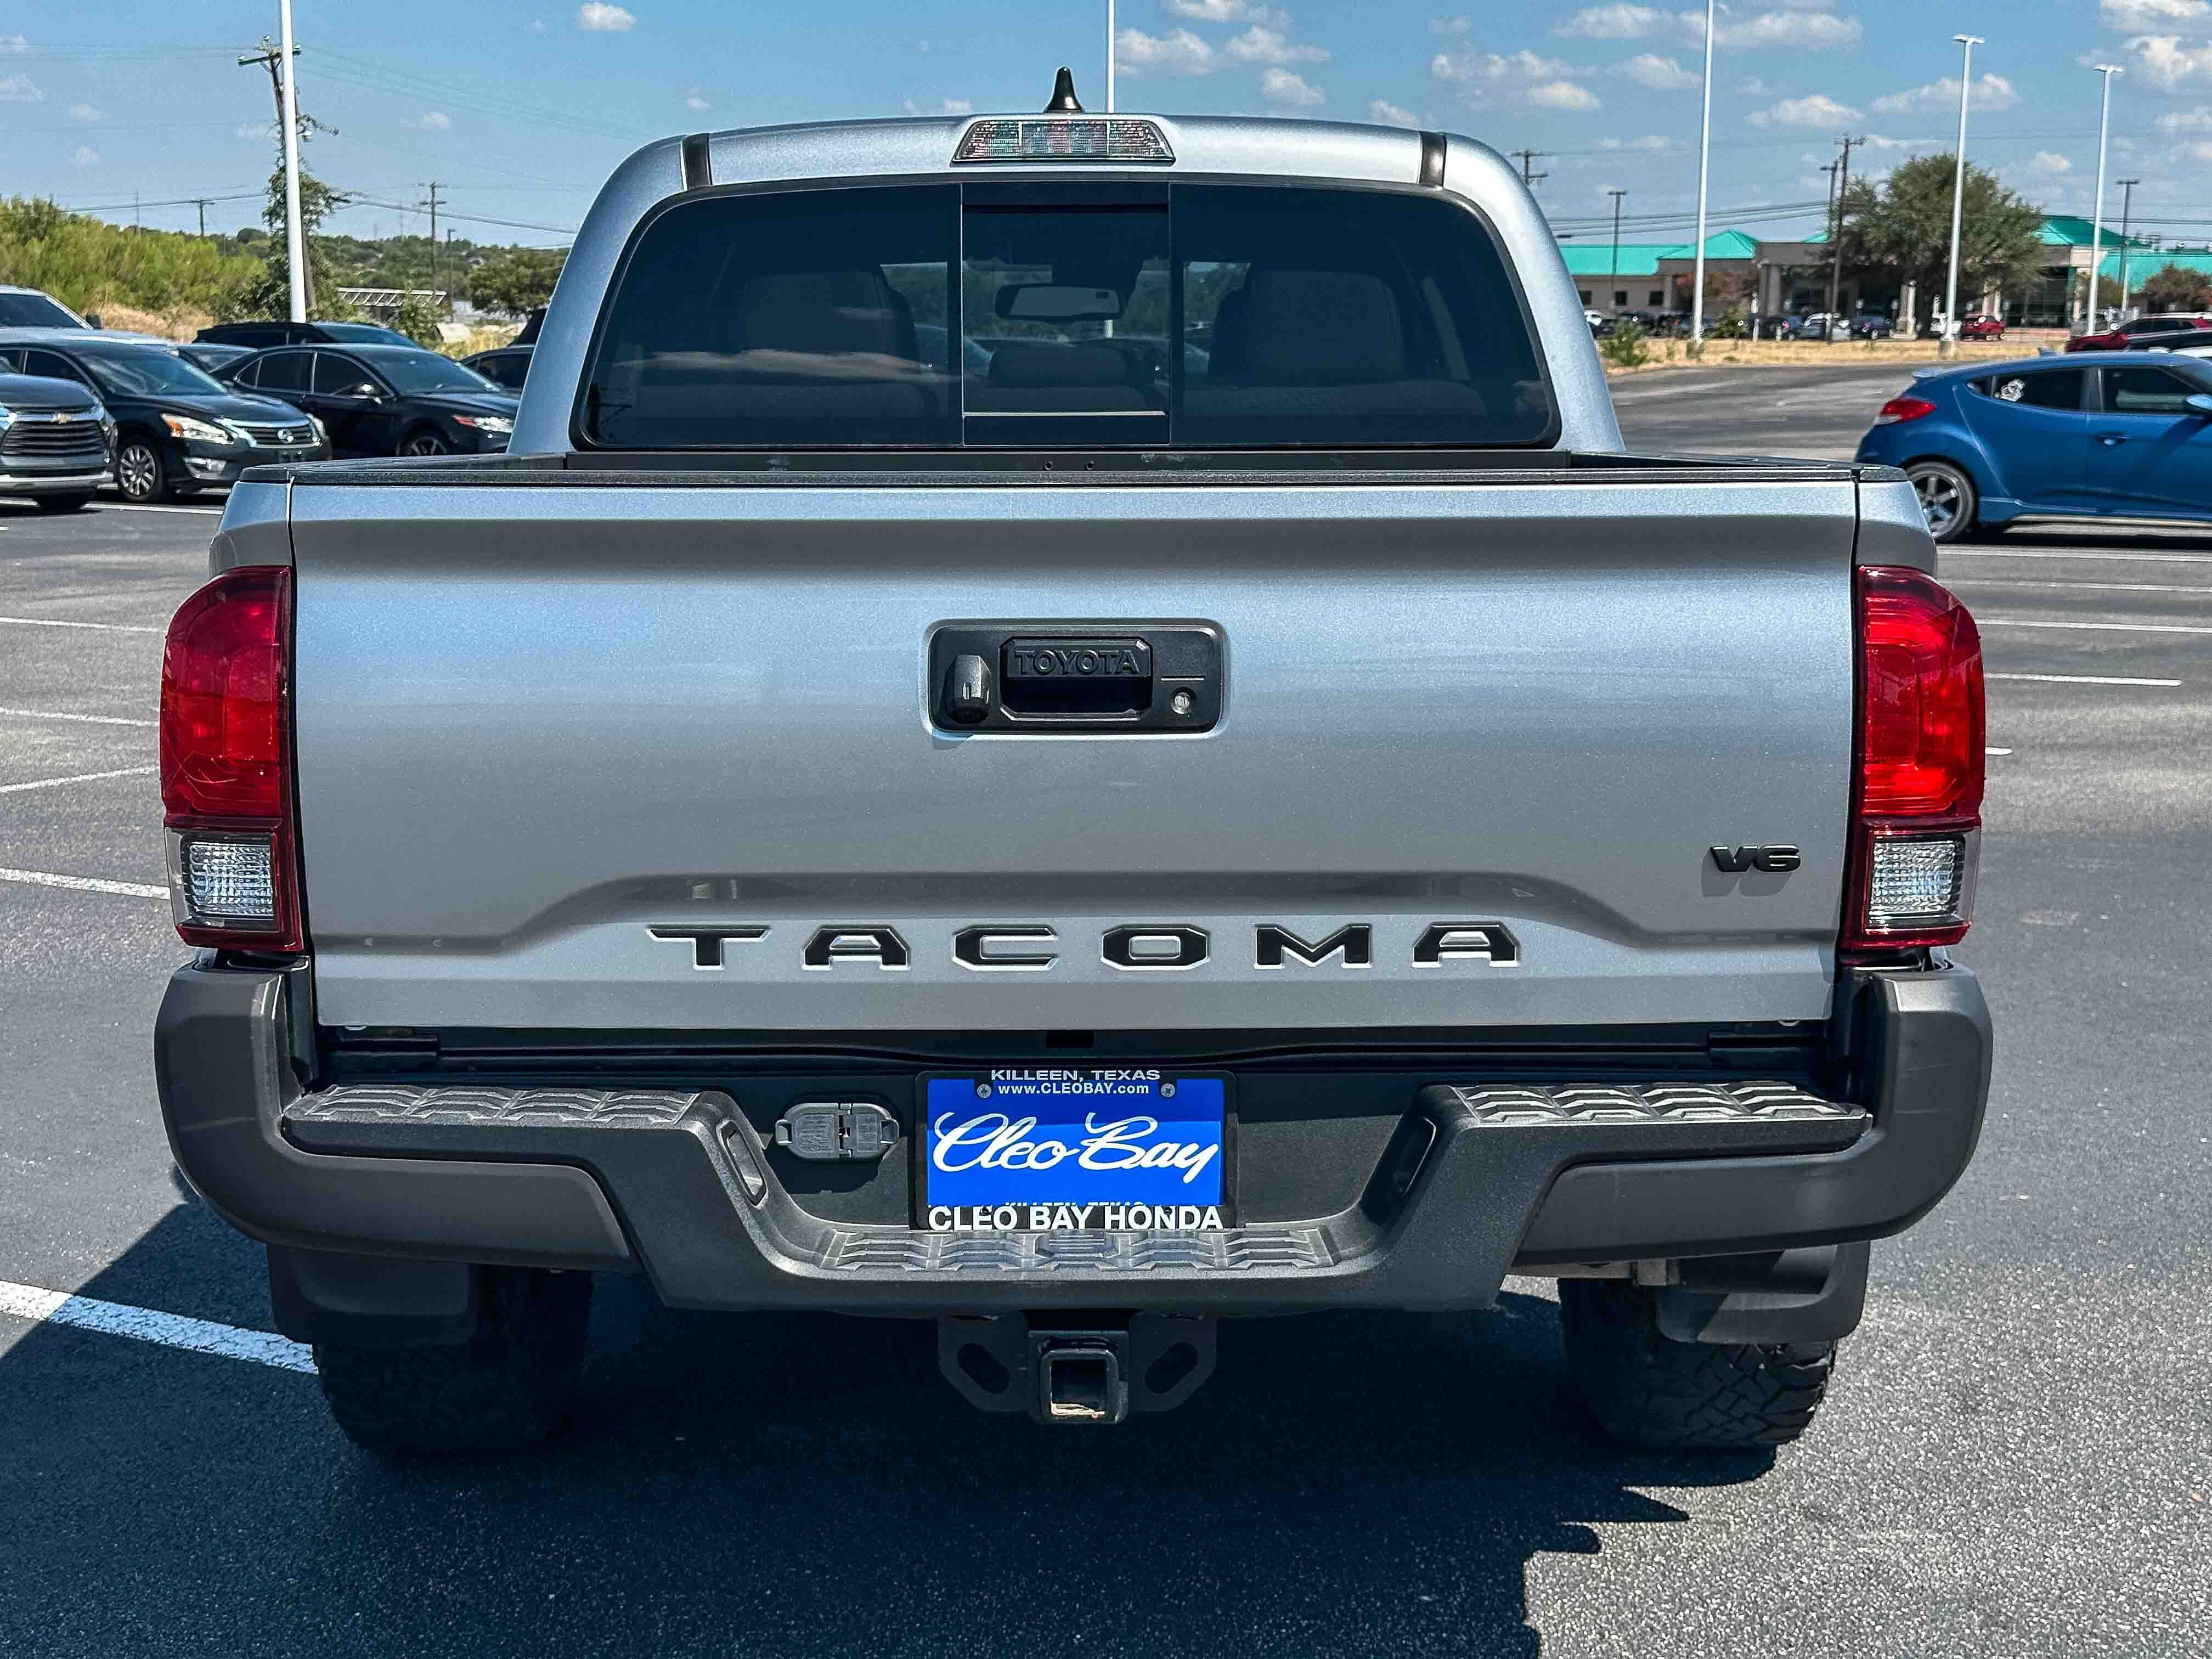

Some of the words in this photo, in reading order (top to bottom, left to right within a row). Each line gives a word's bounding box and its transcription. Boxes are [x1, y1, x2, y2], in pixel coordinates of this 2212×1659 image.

[1014, 649, 1141, 675] TOYOTA
[1709, 844, 1801, 872] V6
[647, 923, 1520, 971] TACOMA
[991, 1070, 1084, 1082] KILLEEN,
[1091, 1070, 1160, 1080] TEXAS
[998, 1082, 1150, 1094] www.CLEOBAY.com
[932, 1112, 1080, 1172] Cleo
[1079, 1112, 1219, 1184] Bay
[928, 1205, 1018, 1230] CLEO
[1029, 1206, 1094, 1229] BAY
[1104, 1205, 1223, 1230] HONDA
